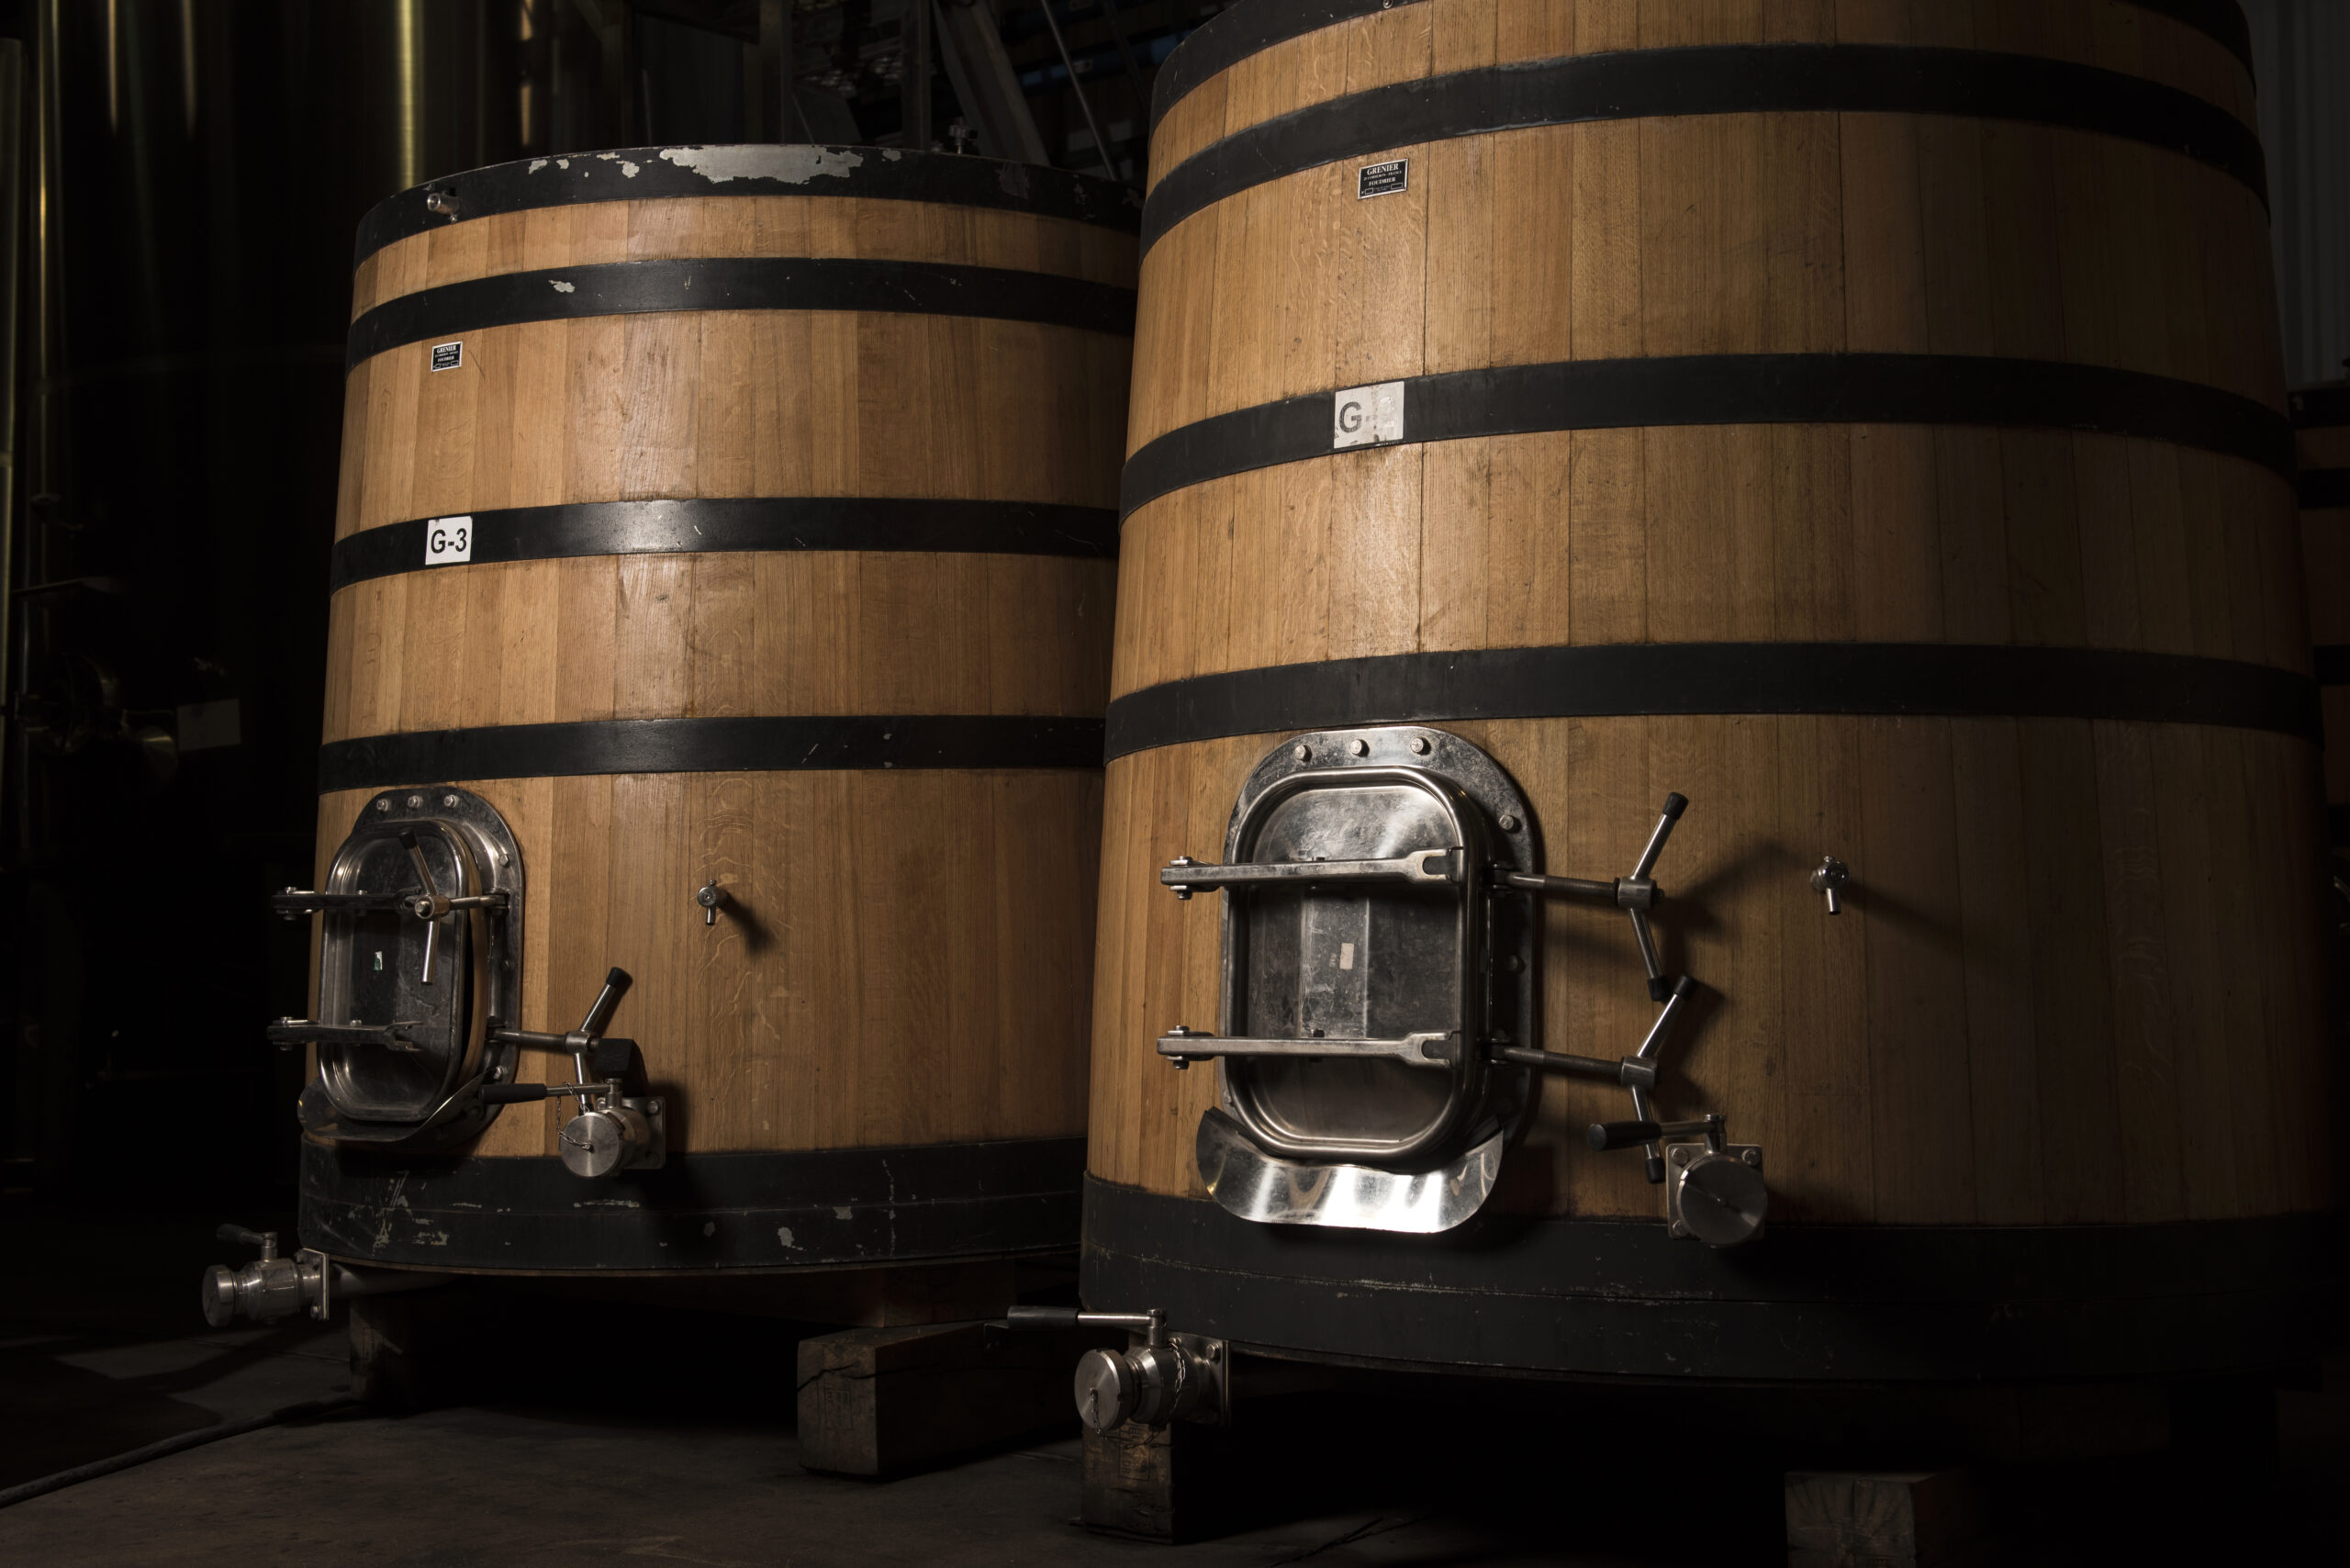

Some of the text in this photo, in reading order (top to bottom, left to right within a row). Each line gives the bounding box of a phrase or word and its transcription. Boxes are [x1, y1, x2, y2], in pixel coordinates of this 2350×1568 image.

[1367, 163, 1399, 175] GRENIER
[1369, 177, 1395, 186] FOUDRIER
[436, 345, 456, 353] GRENIER
[431, 528, 467, 554] G-3
